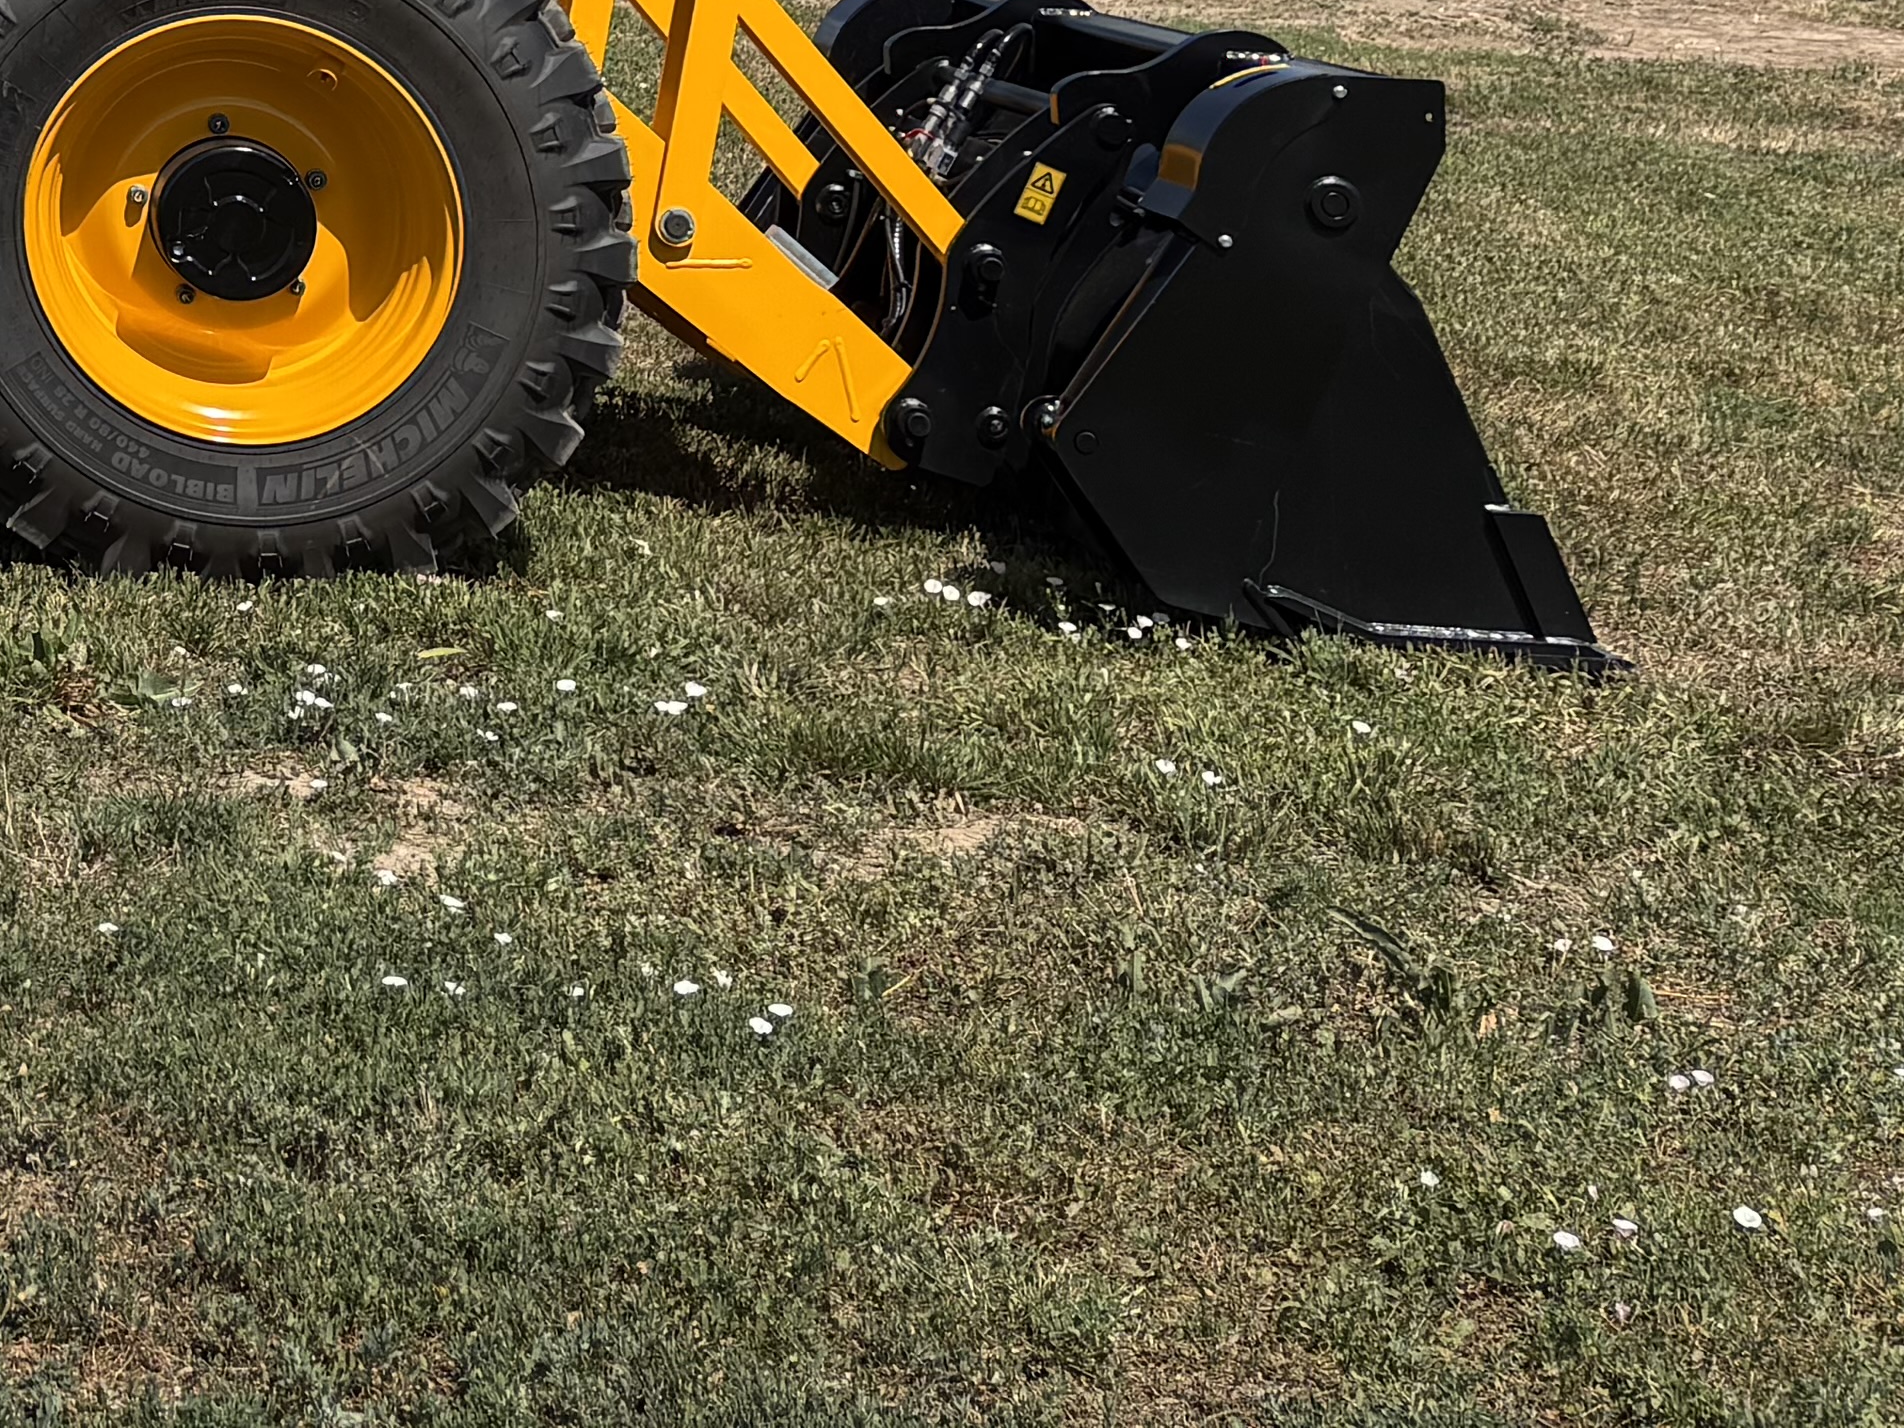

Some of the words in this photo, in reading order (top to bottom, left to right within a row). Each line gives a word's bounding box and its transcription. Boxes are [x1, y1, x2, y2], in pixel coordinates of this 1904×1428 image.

[14, 364, 67, 422] SURFACE
[52, 384, 76, 410] 28
[72, 403, 89, 421] R
[64, 419, 104, 453] HARD
[87, 417, 152, 459] 440/80
[260, 375, 471, 505] MICHELIN
[110, 450, 235, 503] BIBLOAD
